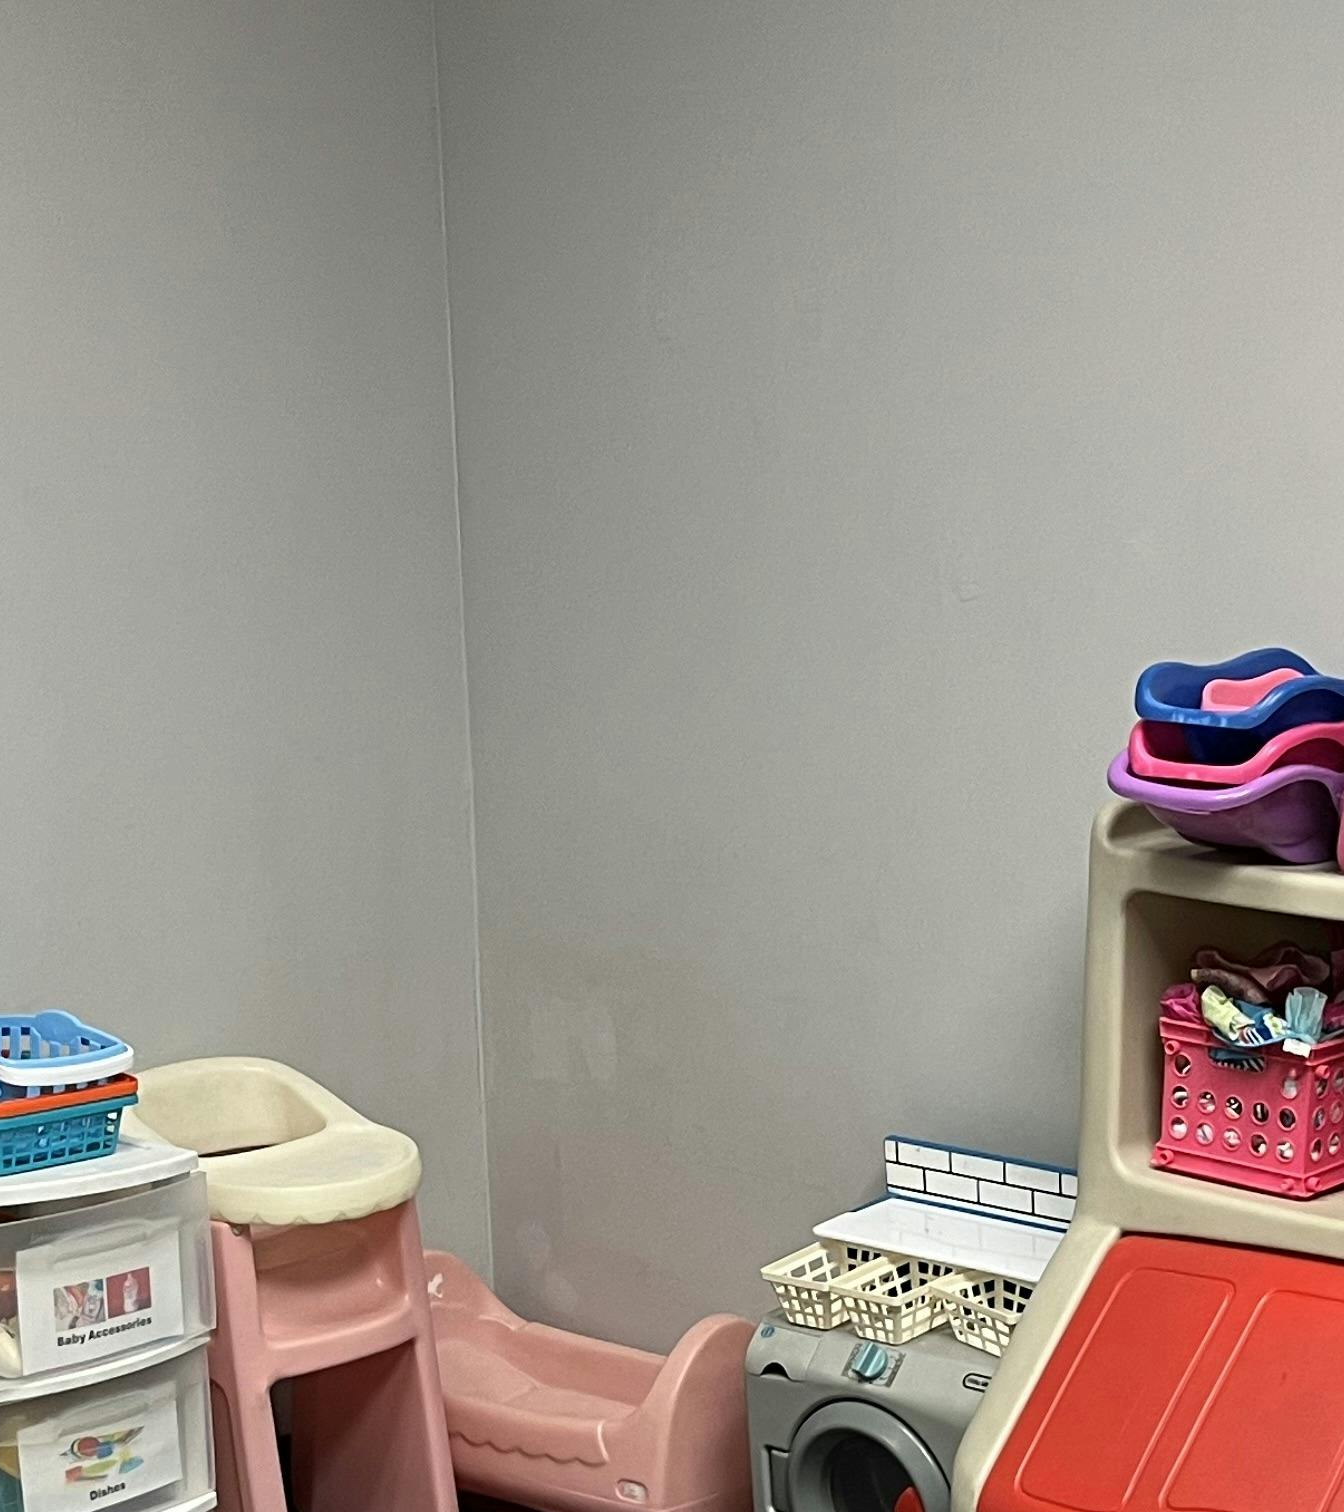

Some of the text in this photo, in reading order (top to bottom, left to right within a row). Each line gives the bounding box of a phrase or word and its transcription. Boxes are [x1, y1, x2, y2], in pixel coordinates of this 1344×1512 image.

[57, 1316, 152, 1347] Baby Accessories
[89, 1482, 126, 1501] Dishes
